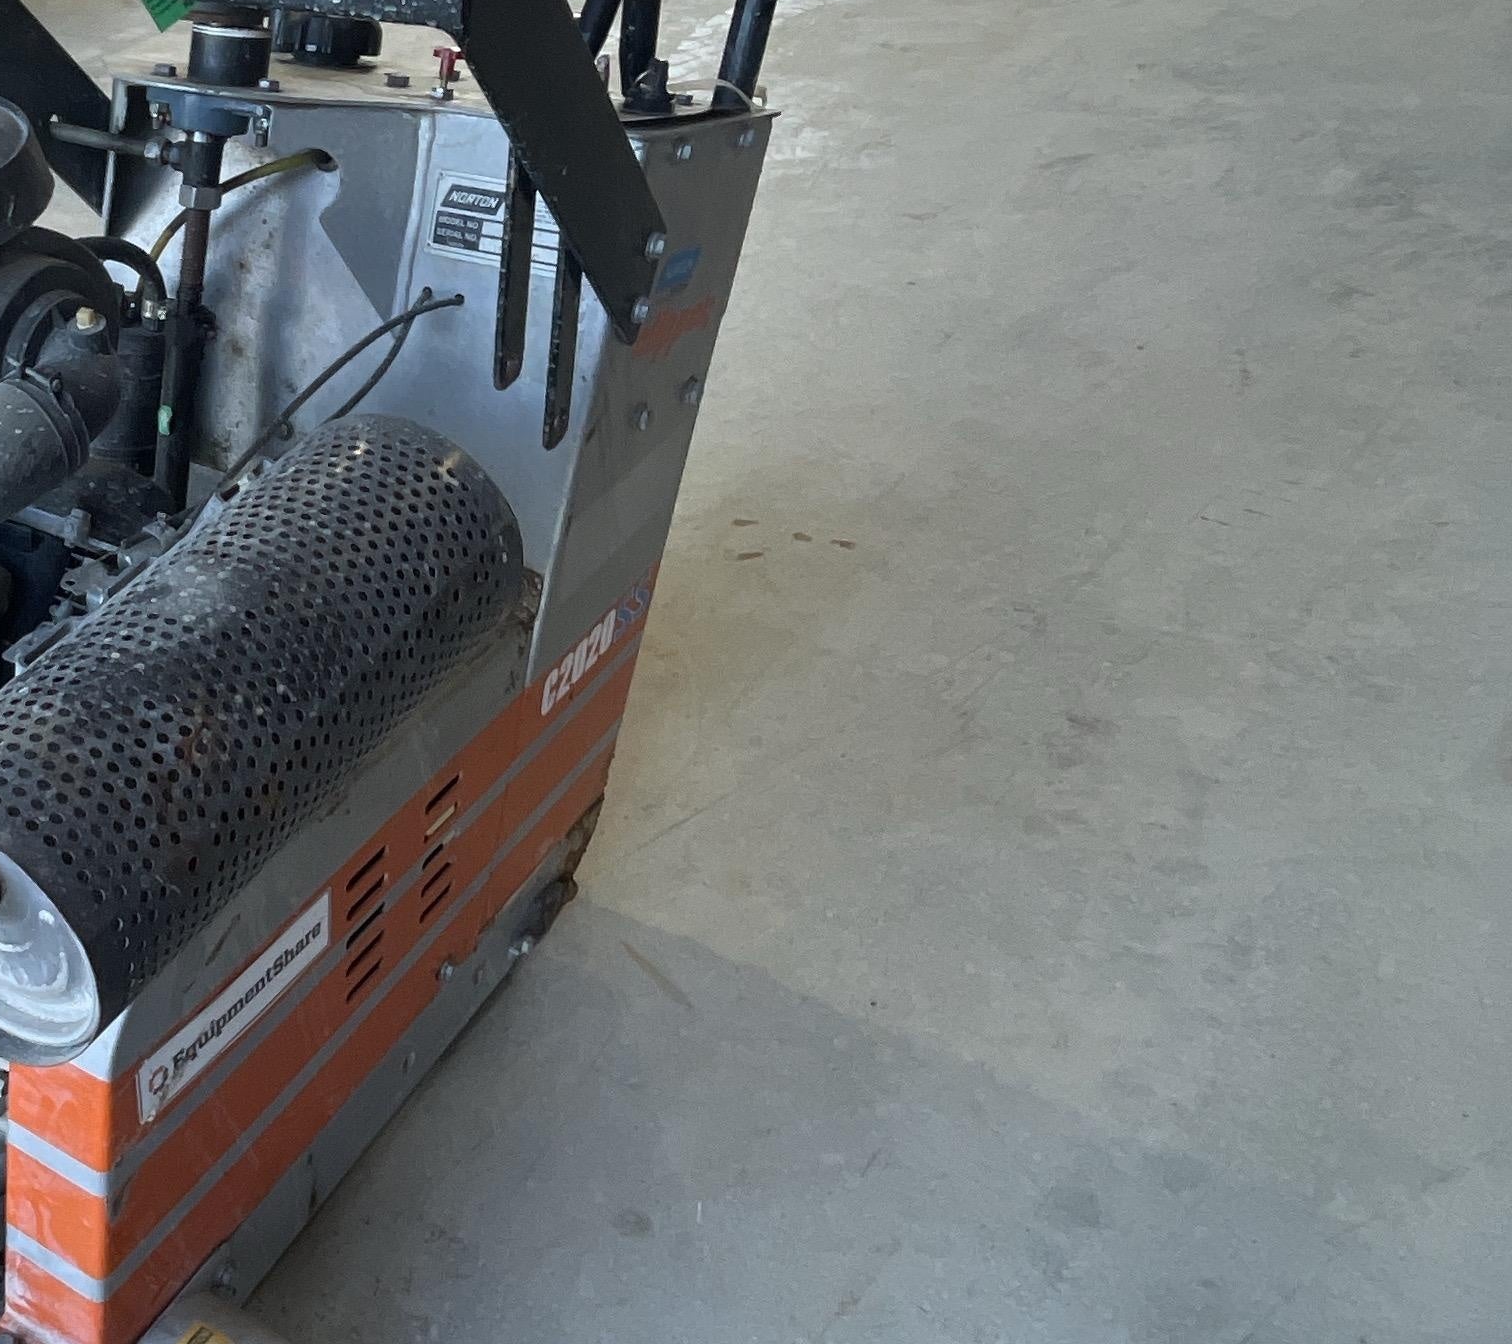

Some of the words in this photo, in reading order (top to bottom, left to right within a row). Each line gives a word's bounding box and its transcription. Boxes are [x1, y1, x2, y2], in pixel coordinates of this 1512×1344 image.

[449, 190, 500, 209] NORTON
[540, 607, 617, 717] C2020
[171, 921, 322, 1071] EquipmentShare
